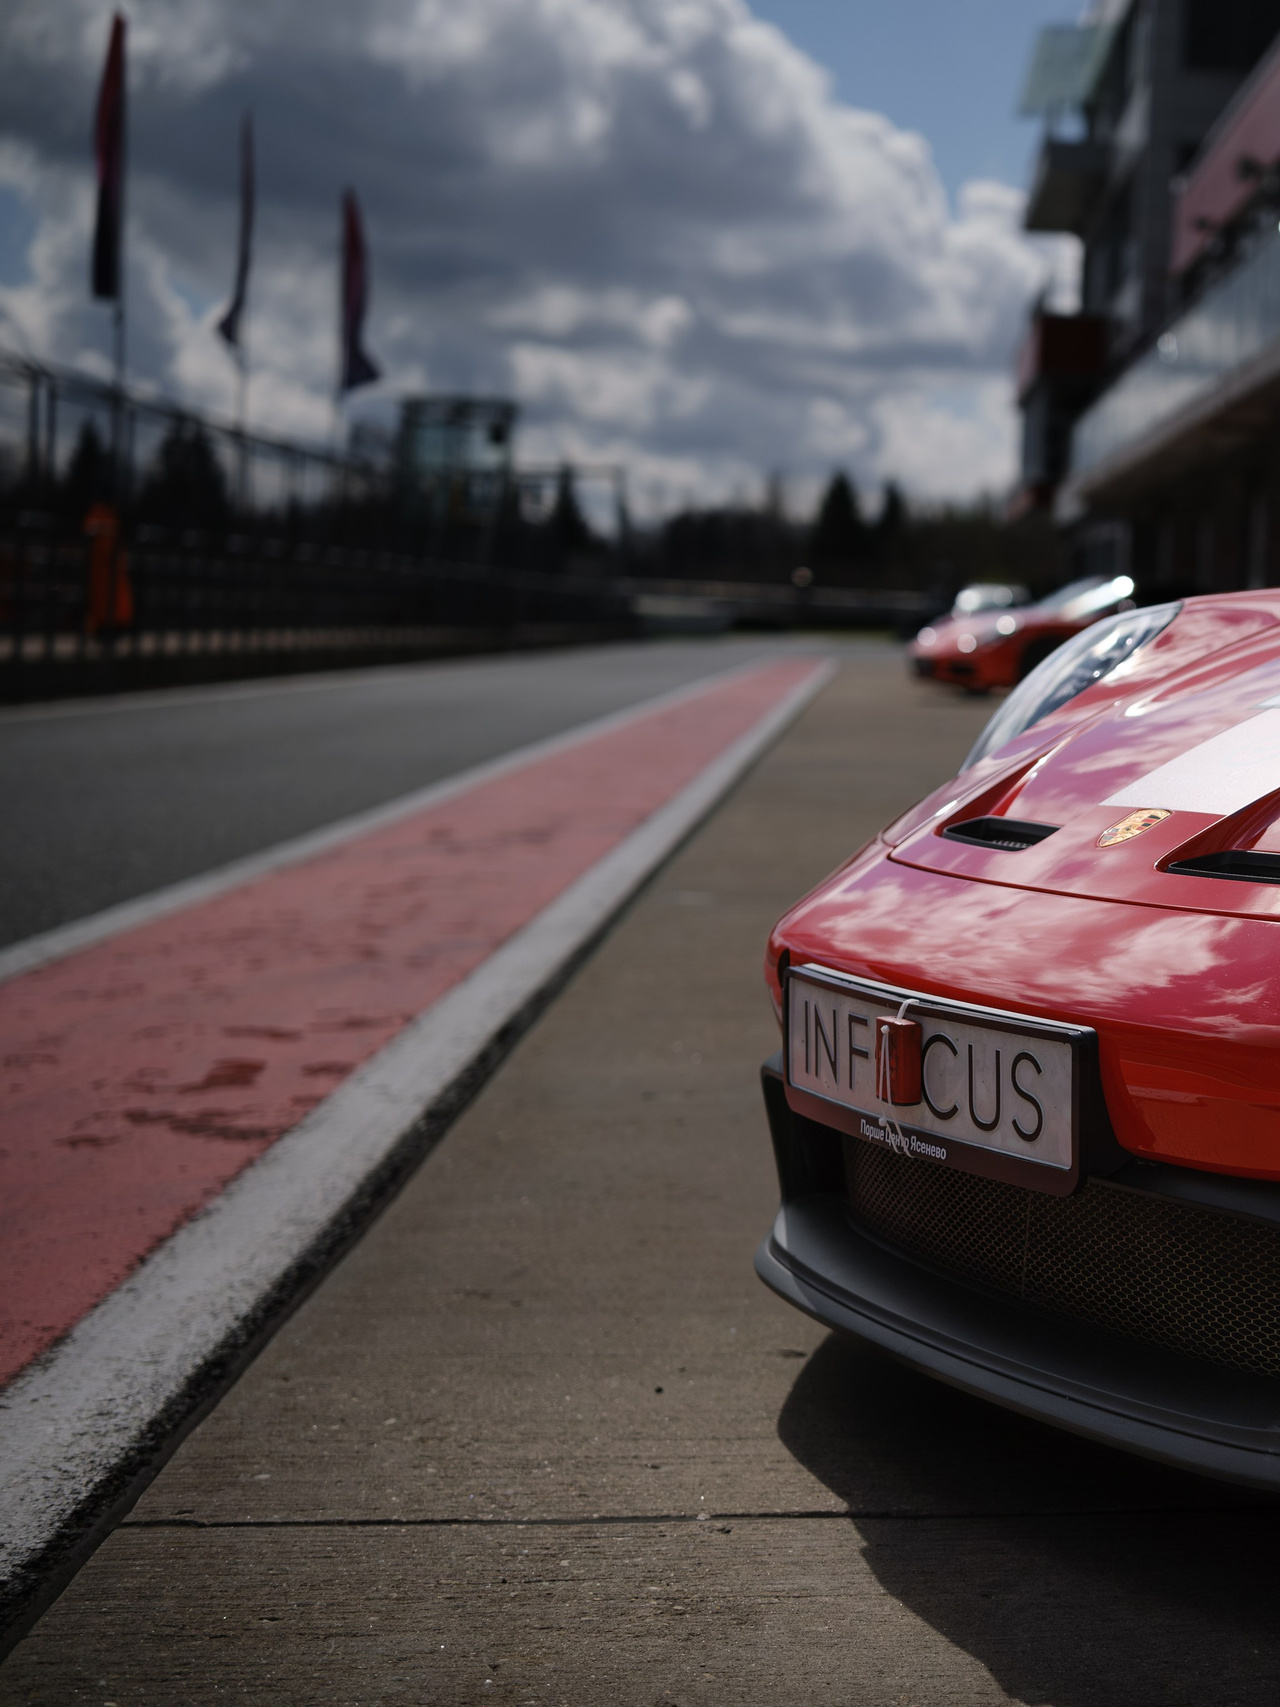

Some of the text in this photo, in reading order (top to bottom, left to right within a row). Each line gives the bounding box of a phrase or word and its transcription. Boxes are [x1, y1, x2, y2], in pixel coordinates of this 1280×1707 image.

[804, 1000, 1044, 1143] INFCUS
[861, 1118, 885, 1140] Порше
[910, 1136, 947, 1160] Ясенево
